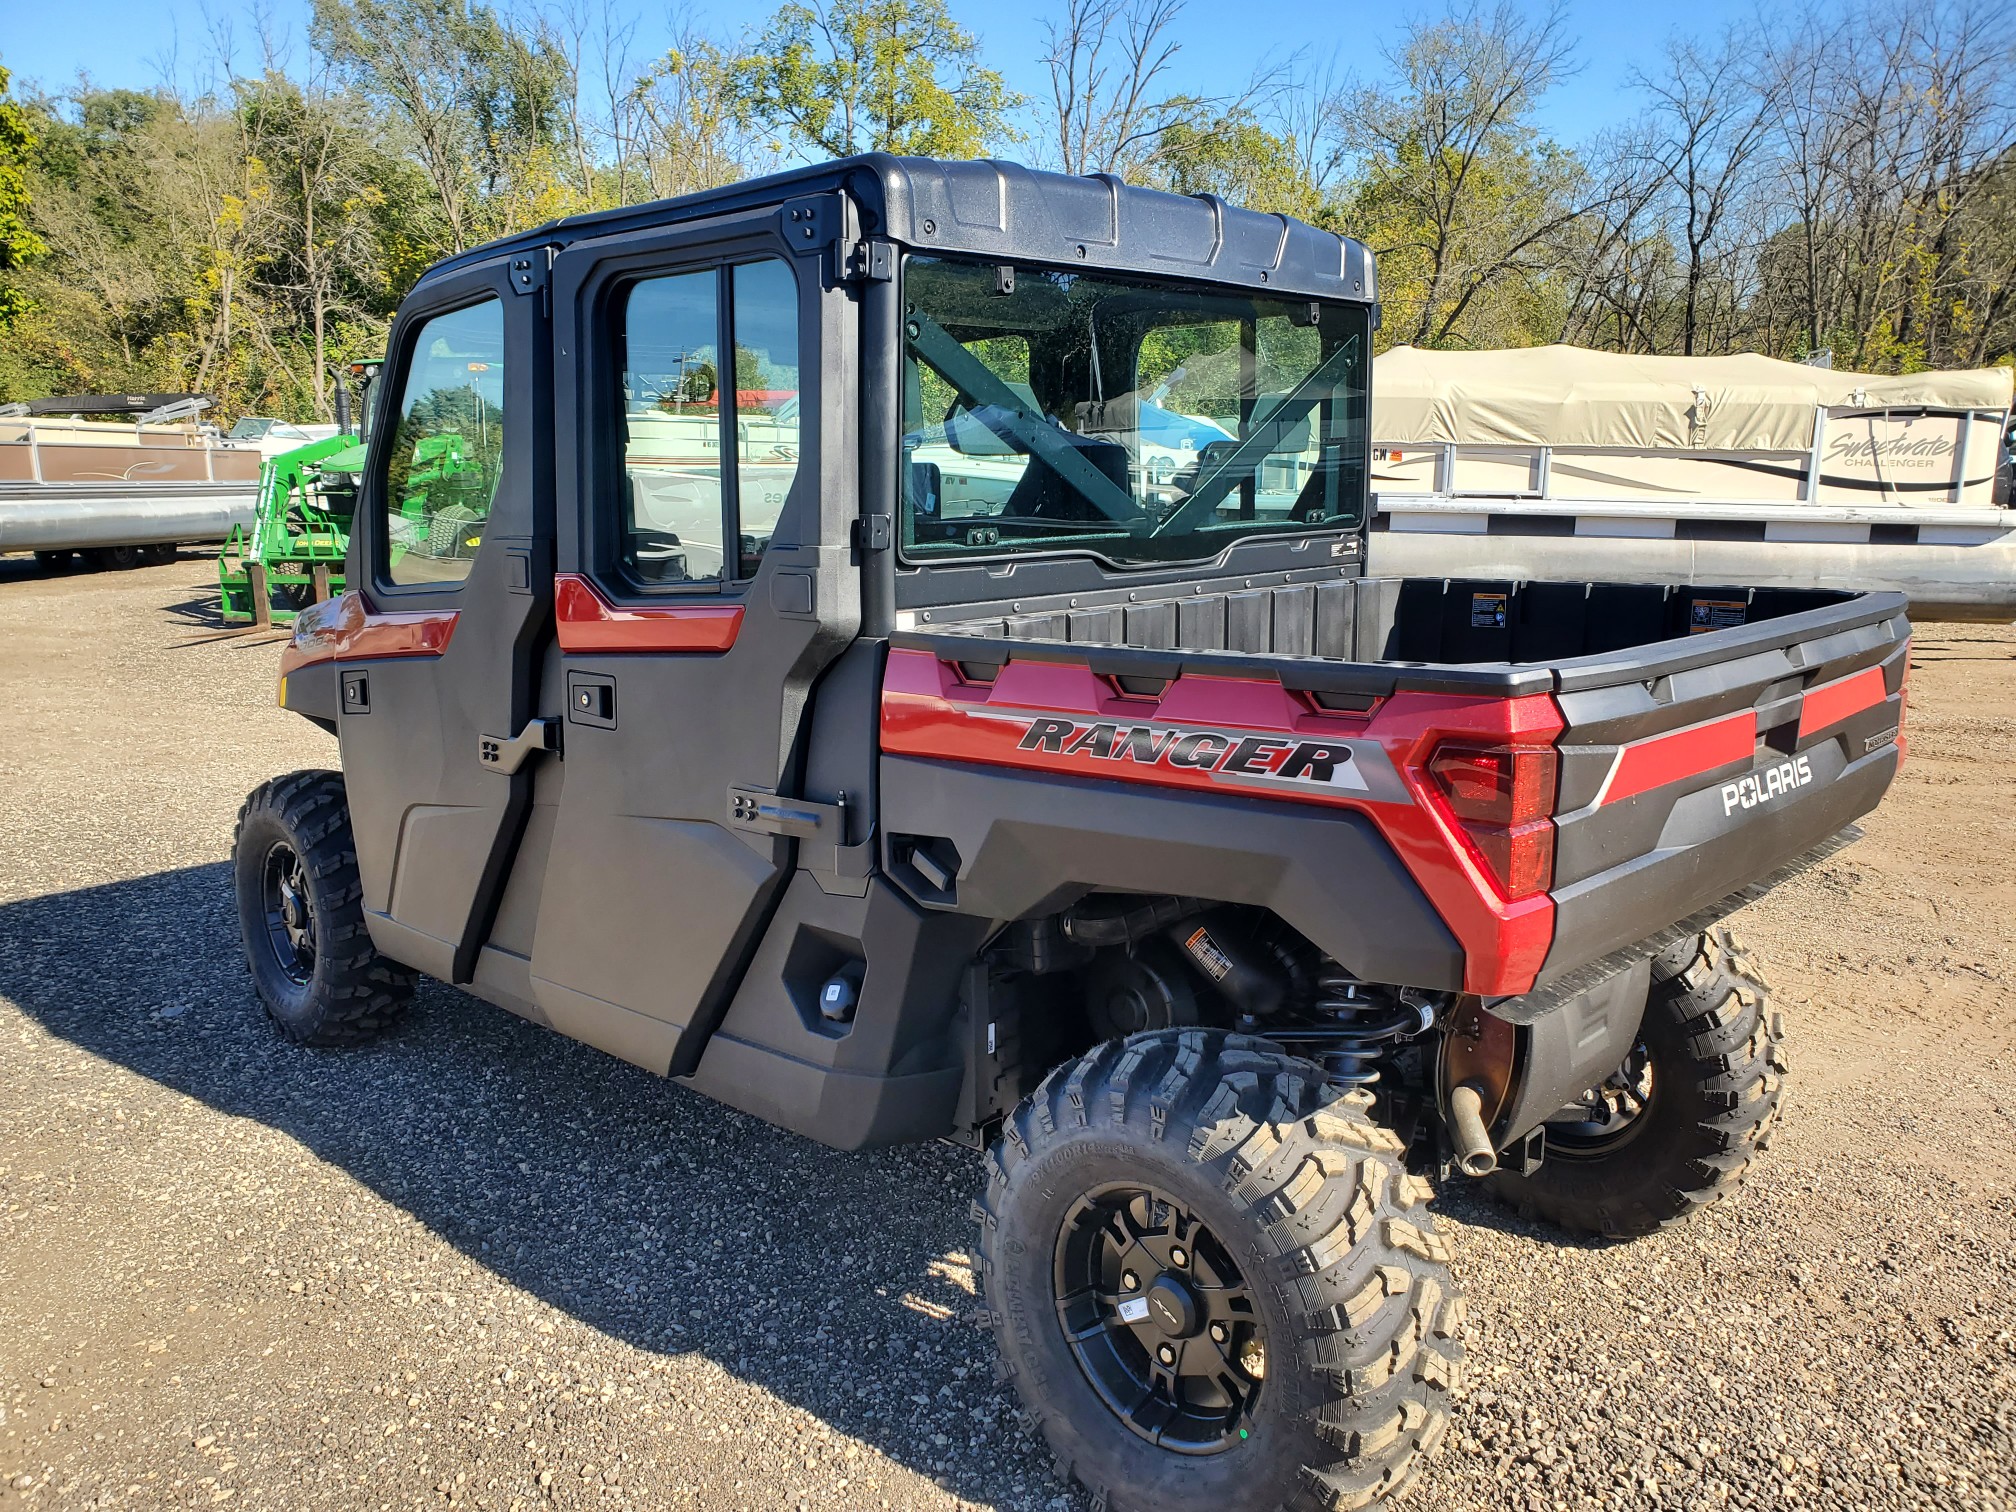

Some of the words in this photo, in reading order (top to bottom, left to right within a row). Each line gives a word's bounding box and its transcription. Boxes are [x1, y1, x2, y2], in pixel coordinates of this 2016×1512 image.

[1821, 432, 1961, 462] Sweetwater
[1844, 458, 1935, 468] CHALLENGER
[1016, 718, 1352, 782] RANGER
[1721, 755, 1812, 817] POLARIS
